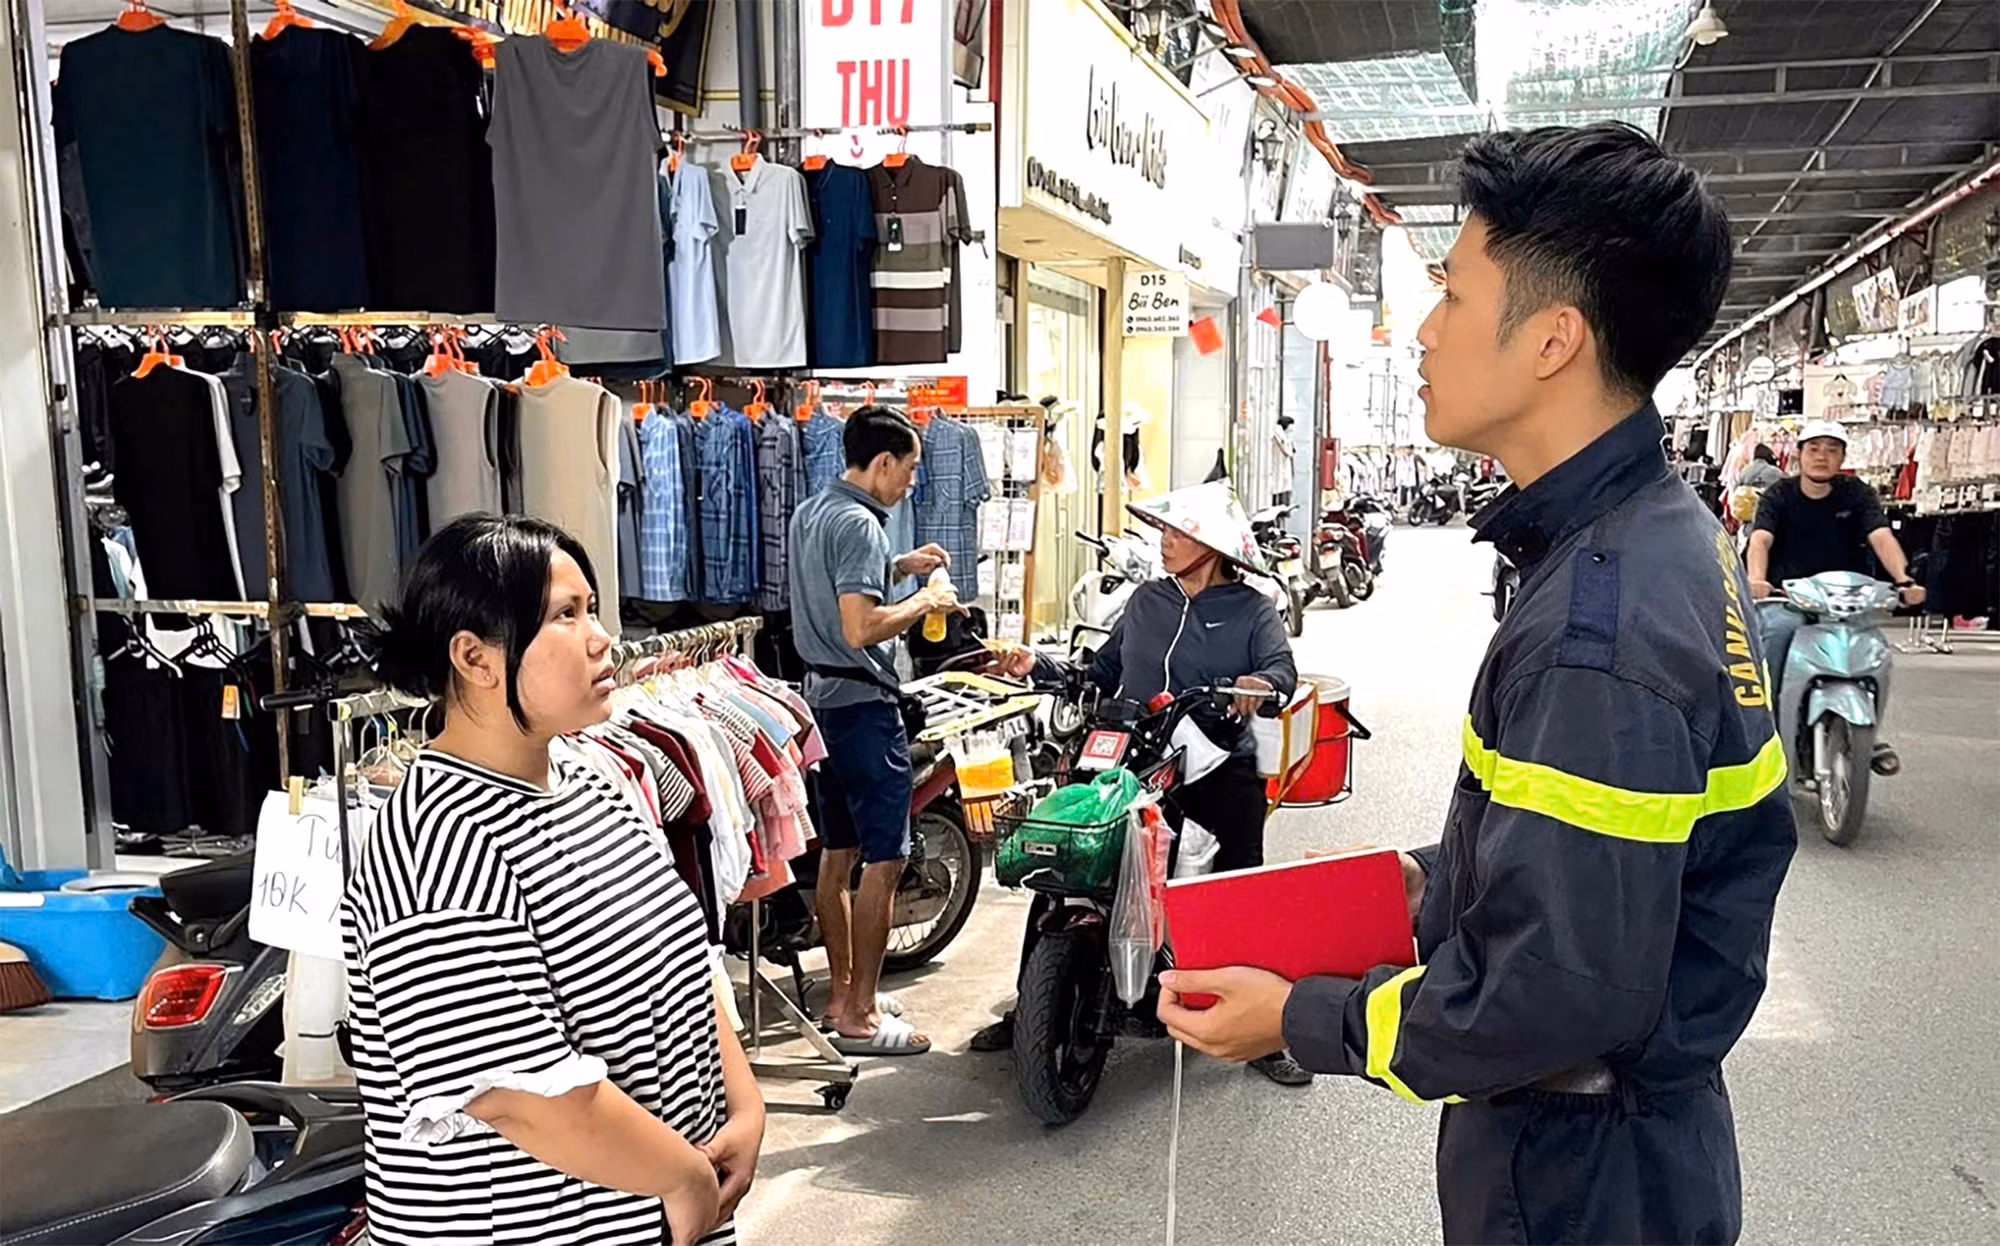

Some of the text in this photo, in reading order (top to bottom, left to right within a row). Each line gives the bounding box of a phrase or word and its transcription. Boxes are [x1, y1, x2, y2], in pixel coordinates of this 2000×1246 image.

[836, 58, 910, 128] THU
[1140, 274, 1167, 286] D15
[1128, 291, 1180, 310] Bii Ben
